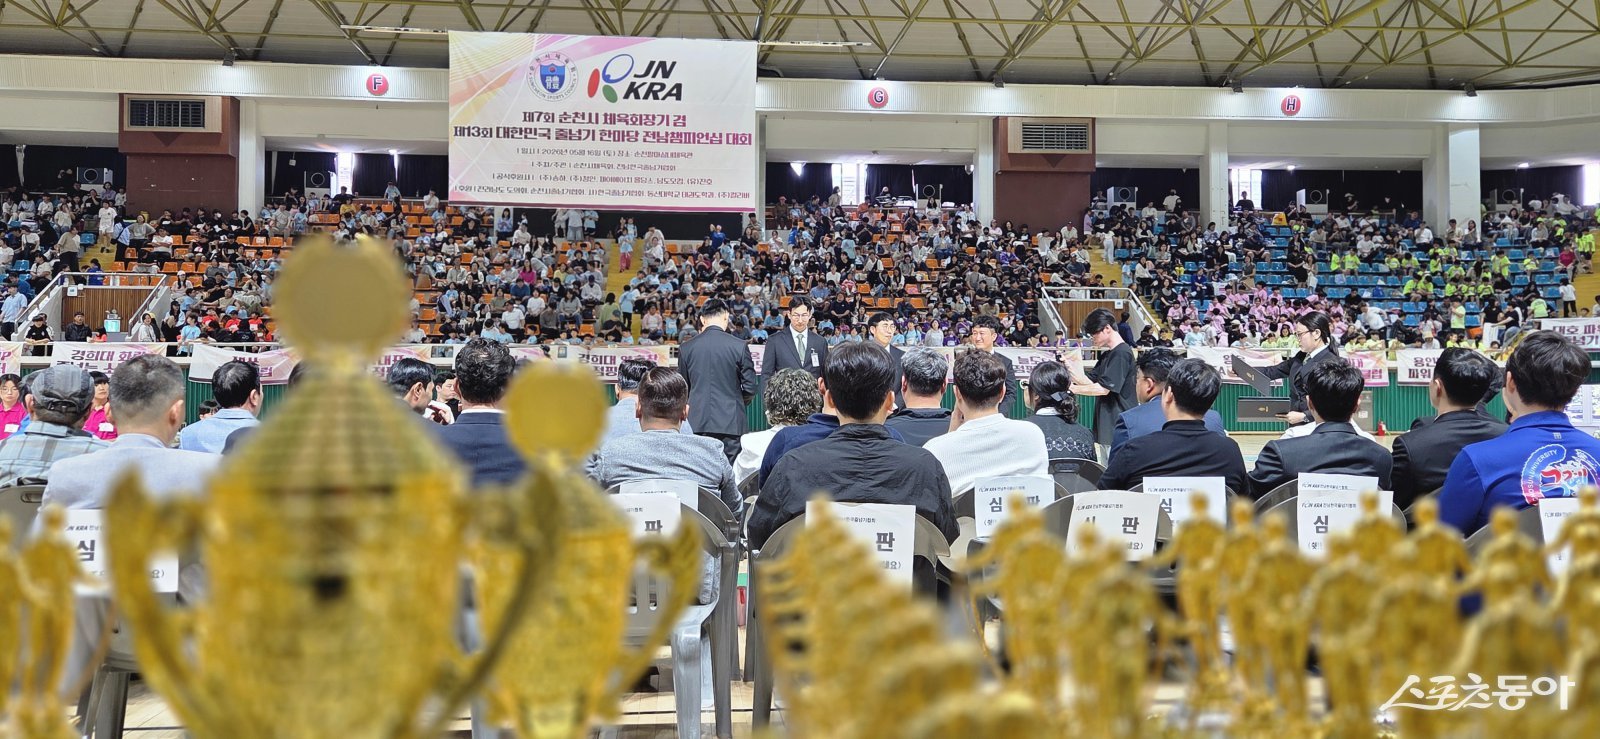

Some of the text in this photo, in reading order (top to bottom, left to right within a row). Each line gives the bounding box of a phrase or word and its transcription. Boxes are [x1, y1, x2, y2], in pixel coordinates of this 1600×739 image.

[633, 60, 677, 79] JN
[372, 76, 382, 90] F
[622, 81, 683, 101] KRA
[873, 89, 884, 103] G
[1286, 98, 1297, 111] H
[522, 111, 555, 123] 제7회
[558, 112, 599, 125] 순천시
[602, 112, 670, 127] 체육회장기
[453, 126, 752, 145] 제13회 대한민국 줄넘기 한마당 전남챔피언십 대회
[1583, 324, 1600, 335] 파
[71, 349, 115, 361] 경희대
[579, 353, 617, 365] 경희대
[1413, 356, 1438, 367] 용인
[1529, 449, 1558, 477] UNIVERSITY
[989, 497, 1003, 512] 심
[1160, 498, 1172, 513] 심
[1122, 516, 1140, 534] 판
[1313, 515, 1329, 534] 심
[876, 532, 895, 552] 판
[77, 540, 96, 562] 심
